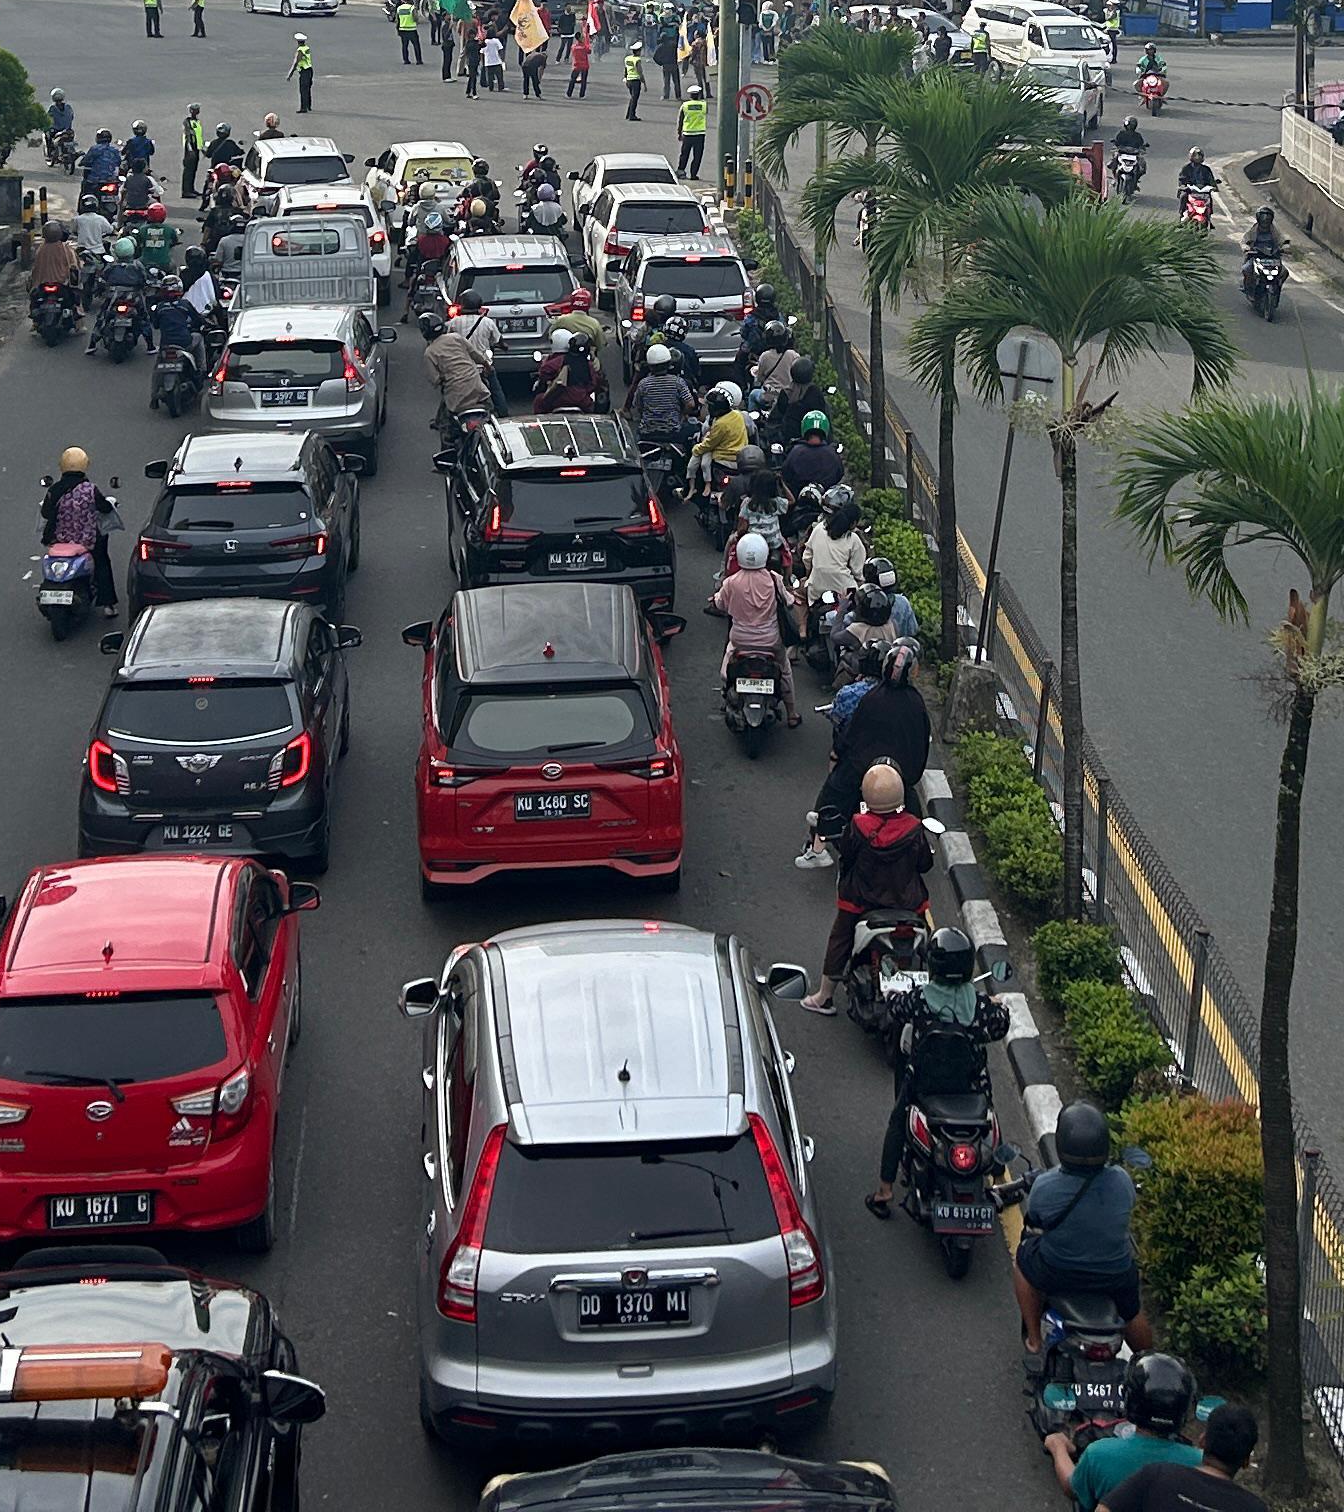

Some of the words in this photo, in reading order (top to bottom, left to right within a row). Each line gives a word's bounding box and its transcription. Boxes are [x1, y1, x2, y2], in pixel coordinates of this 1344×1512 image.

[550, 553, 562, 564] KU
[565, 552, 588, 563] 1727
[592, 552, 605, 562] GL
[517, 797, 533, 811] KU
[537, 795, 567, 810] 1480
[573, 794, 589, 808] SC
[163, 826, 179, 839] KU
[182, 825, 211, 838] 1224
[218, 825, 233, 837] GE
[56, 1199, 75, 1217] KU
[85, 1196, 118, 1216] 1671
[937, 1206, 950, 1218] KU
[581, 1295, 601, 1315] DD
[616, 1293, 653, 1314] 1370
[666, 1290, 687, 1312] MI
[1086, 1384, 1112, 1397] 5467
